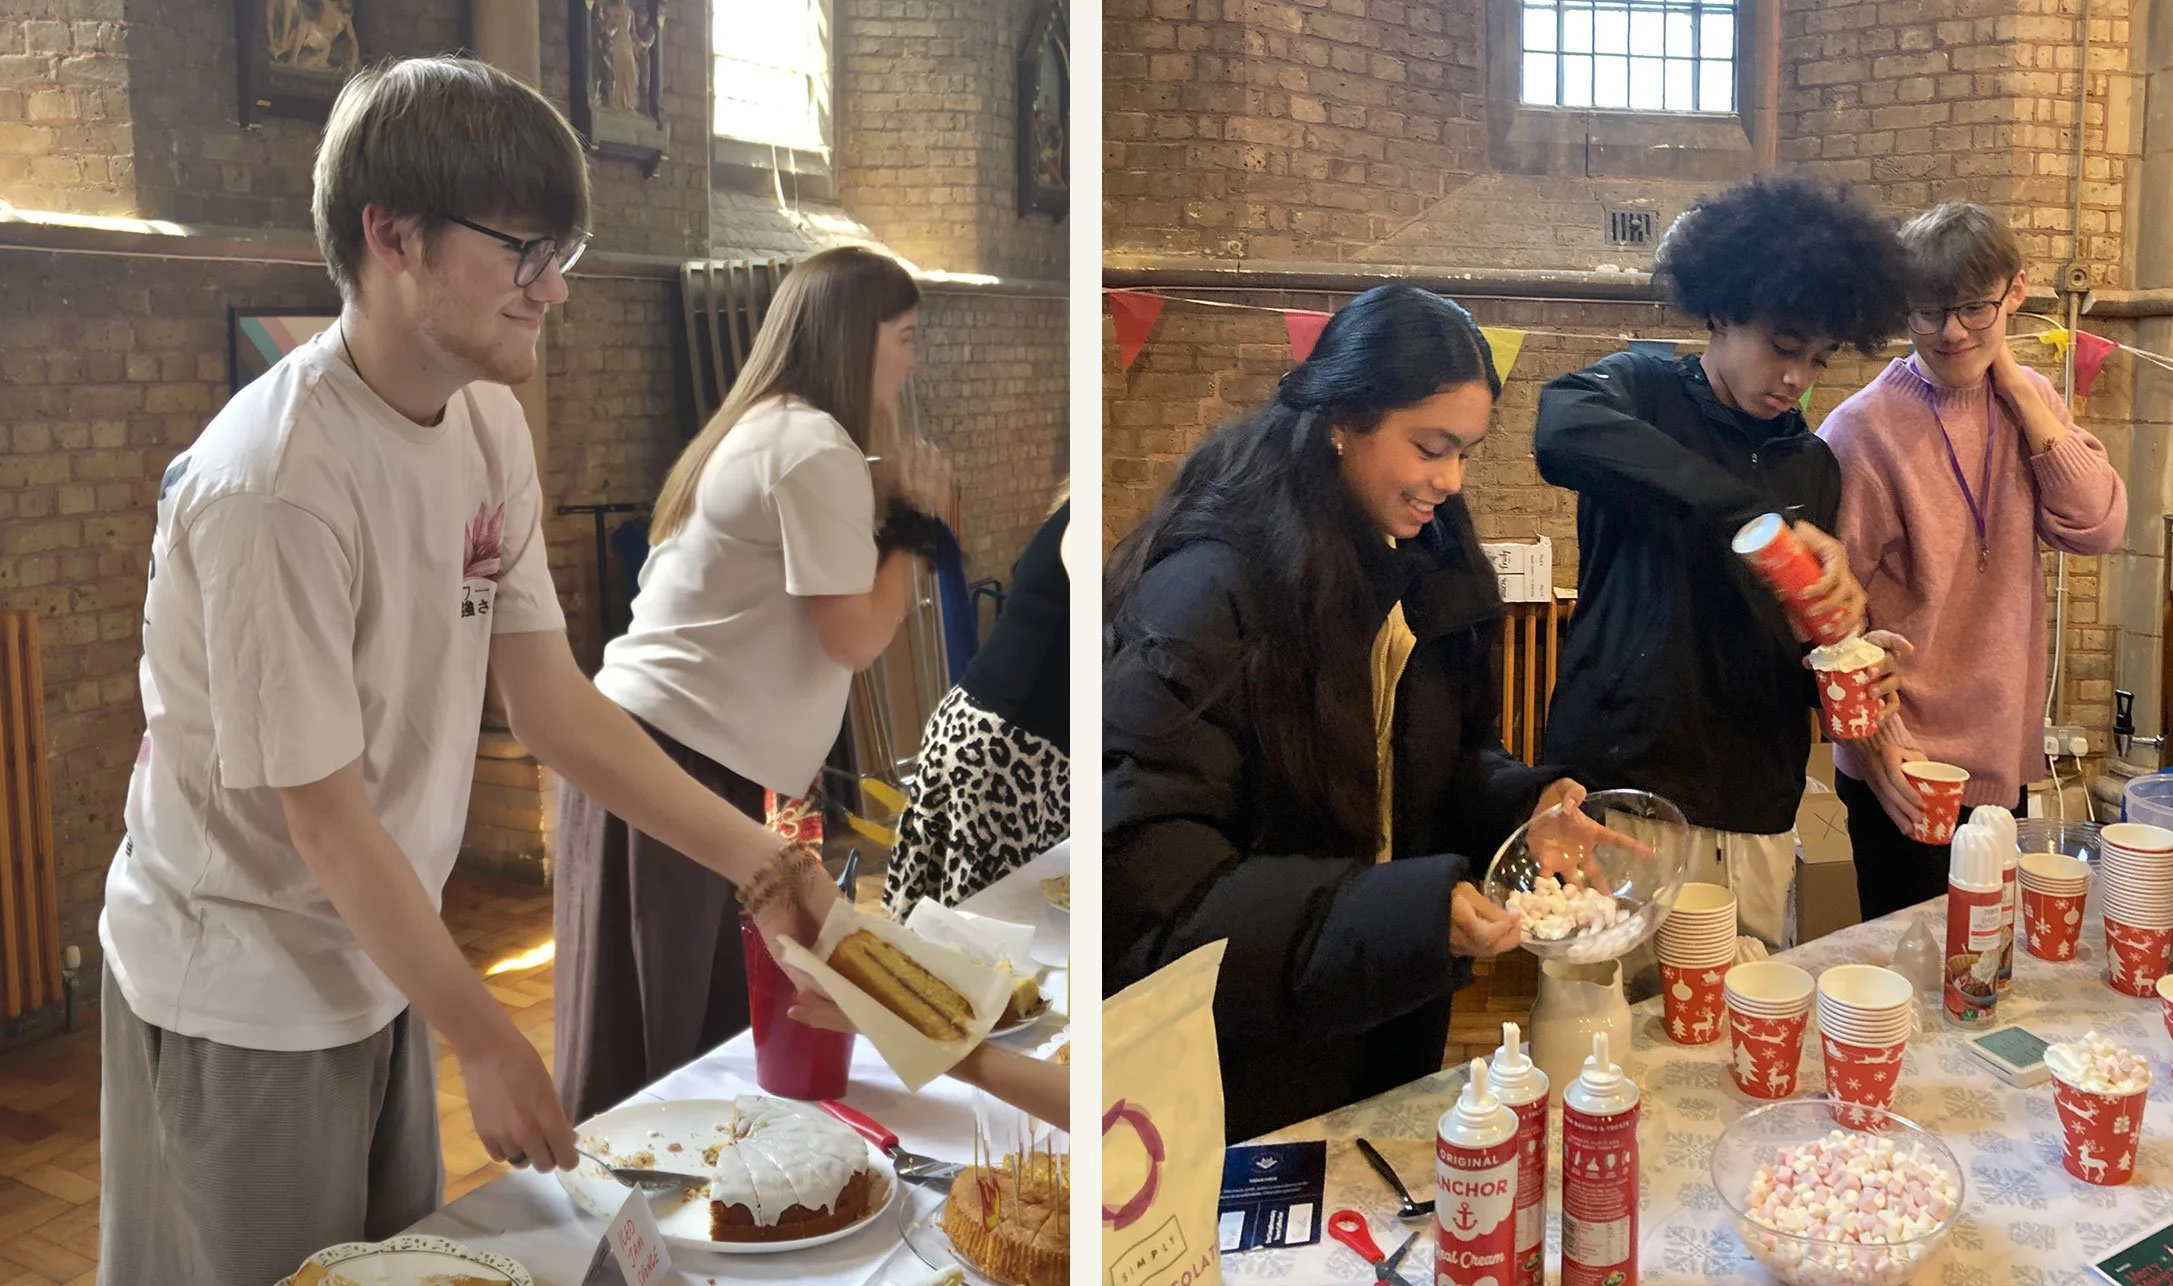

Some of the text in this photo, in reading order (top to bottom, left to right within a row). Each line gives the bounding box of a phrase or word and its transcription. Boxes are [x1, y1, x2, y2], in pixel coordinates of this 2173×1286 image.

[1440, 1149, 1499, 1168] ORIGINAL
[1122, 1235, 1175, 1284] SIMPLY
[1460, 1251, 1506, 1269] Cream
